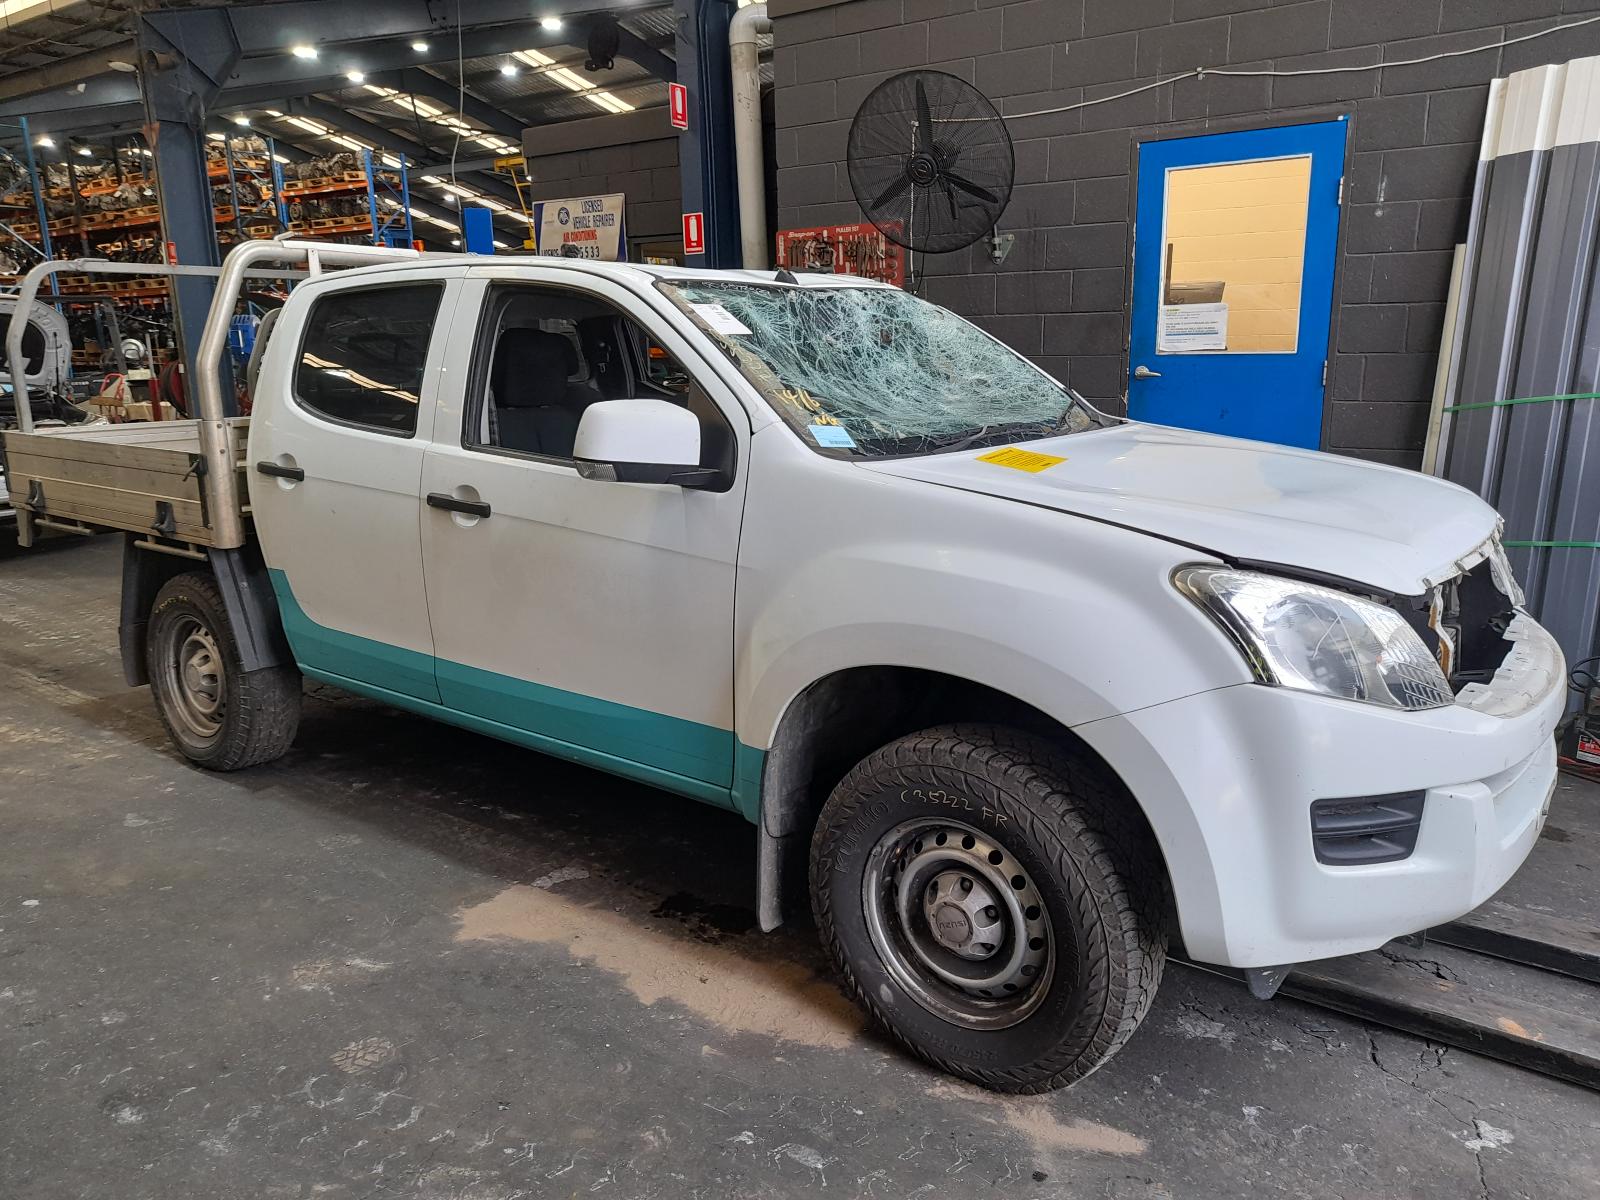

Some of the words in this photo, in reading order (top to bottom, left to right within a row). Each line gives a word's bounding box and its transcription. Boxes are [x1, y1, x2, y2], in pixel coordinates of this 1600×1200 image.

[573, 215, 591, 230] VEHICLE
[592, 213, 616, 228] REPAIRER
[981, 805, 1008, 831] FR
[938, 919, 967, 930] ISUZU
